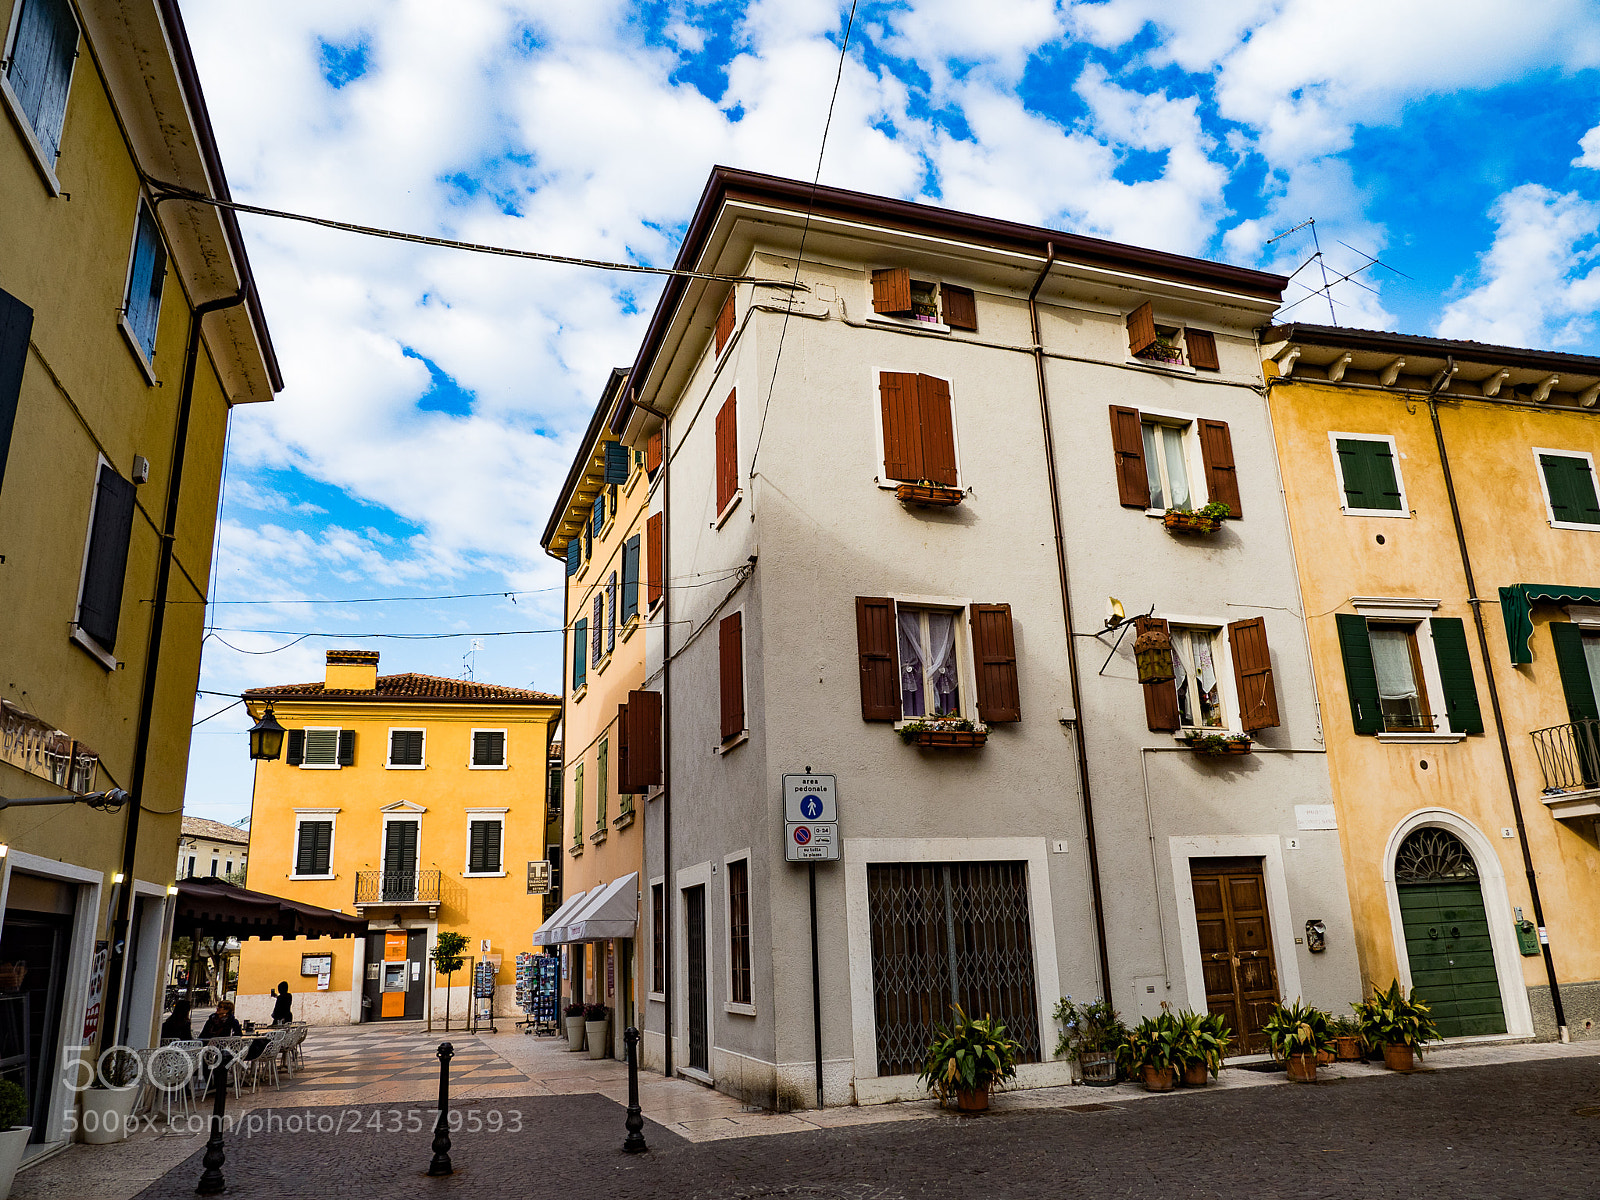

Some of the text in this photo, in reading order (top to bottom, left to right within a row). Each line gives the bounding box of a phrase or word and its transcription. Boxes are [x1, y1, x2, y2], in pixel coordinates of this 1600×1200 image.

[1058, 843, 1062, 851] 1
[1291, 840, 1296, 848] 2
[530, 862, 546, 878] T
